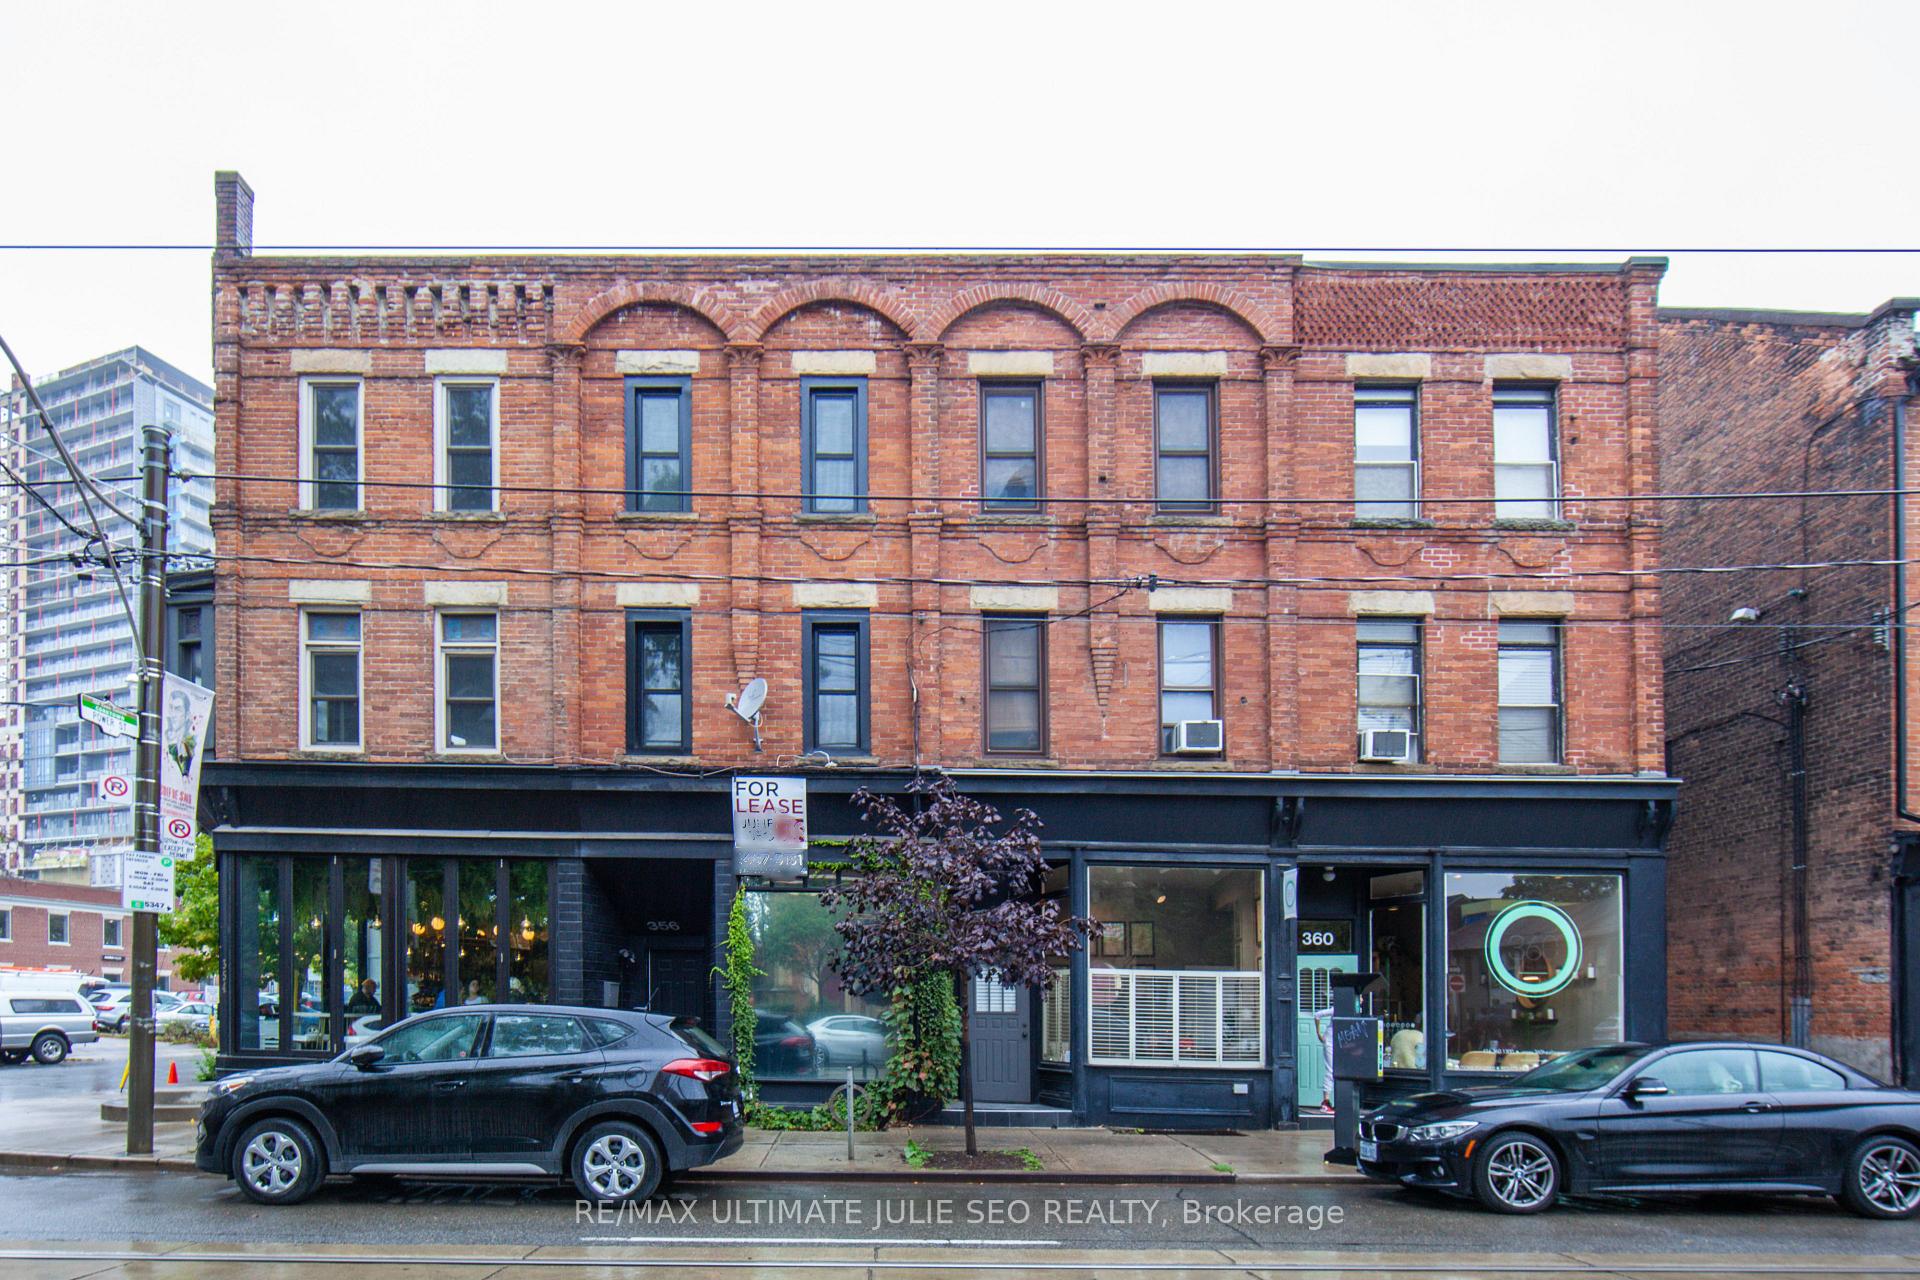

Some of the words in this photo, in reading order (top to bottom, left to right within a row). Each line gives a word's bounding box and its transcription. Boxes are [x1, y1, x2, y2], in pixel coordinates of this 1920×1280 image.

[92, 711, 115, 726] POWER
[119, 721, 127, 731] ST
[735, 781, 779, 797] FOR
[735, 798, 804, 814] LEASE
[144, 901, 165, 909] 5347
[646, 920, 681, 931] 356
[1301, 931, 1334, 946] 360
